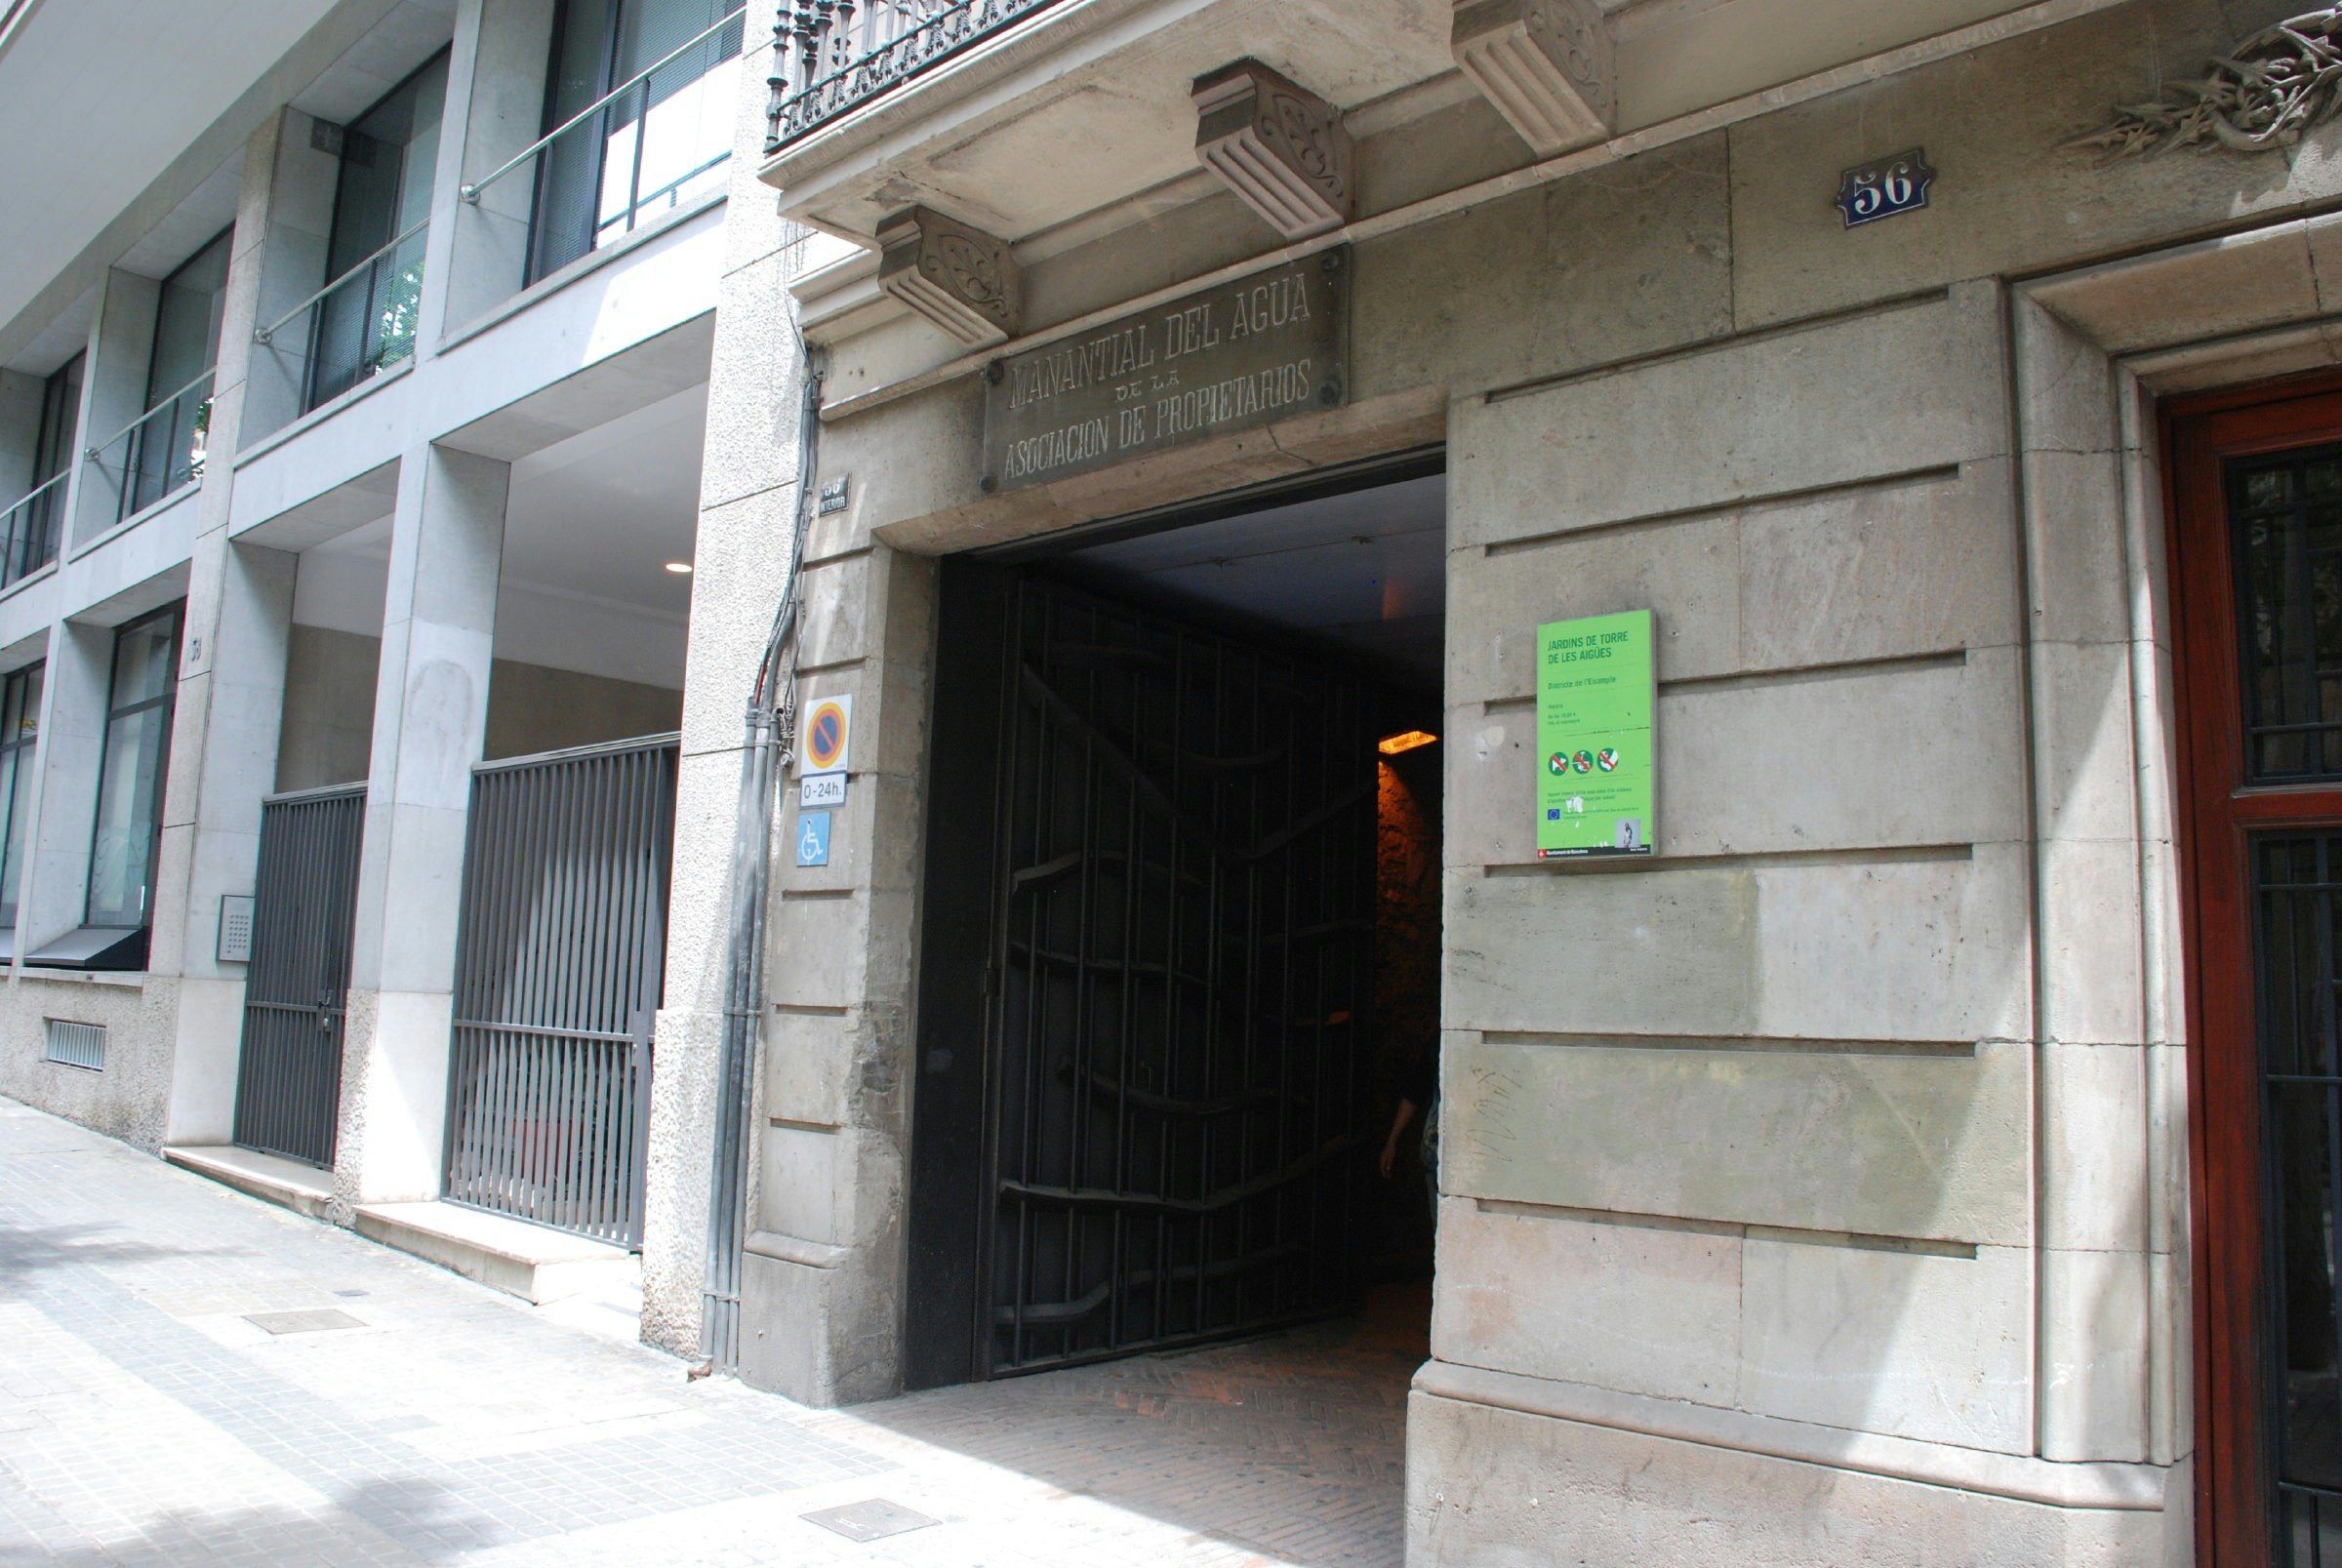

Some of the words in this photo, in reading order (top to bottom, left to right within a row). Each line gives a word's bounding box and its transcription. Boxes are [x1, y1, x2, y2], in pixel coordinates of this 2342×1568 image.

[1853, 161, 1912, 214] 56
[1008, 325, 1155, 411] MANANTIAL
[1165, 303, 1221, 360] DEL
[1230, 273, 1310, 341] AGUA
[1114, 382, 1142, 403] DE
[1151, 370, 1180, 389] LA
[1005, 417, 1110, 480] ASOCIACION
[1118, 405, 1146, 450] DE
[1154, 358, 1311, 440] PROPIETARIOS
[1548, 637, 1583, 651] JARDINS
[1586, 635, 1596, 646] DE
[1600, 630, 1629, 644] TORRE
[1548, 654, 1558, 663] DE
[1561, 651, 1577, 663] LES
[1580, 646, 1611, 661] AIGÜES
[1548, 680, 1573, 690] Districte
